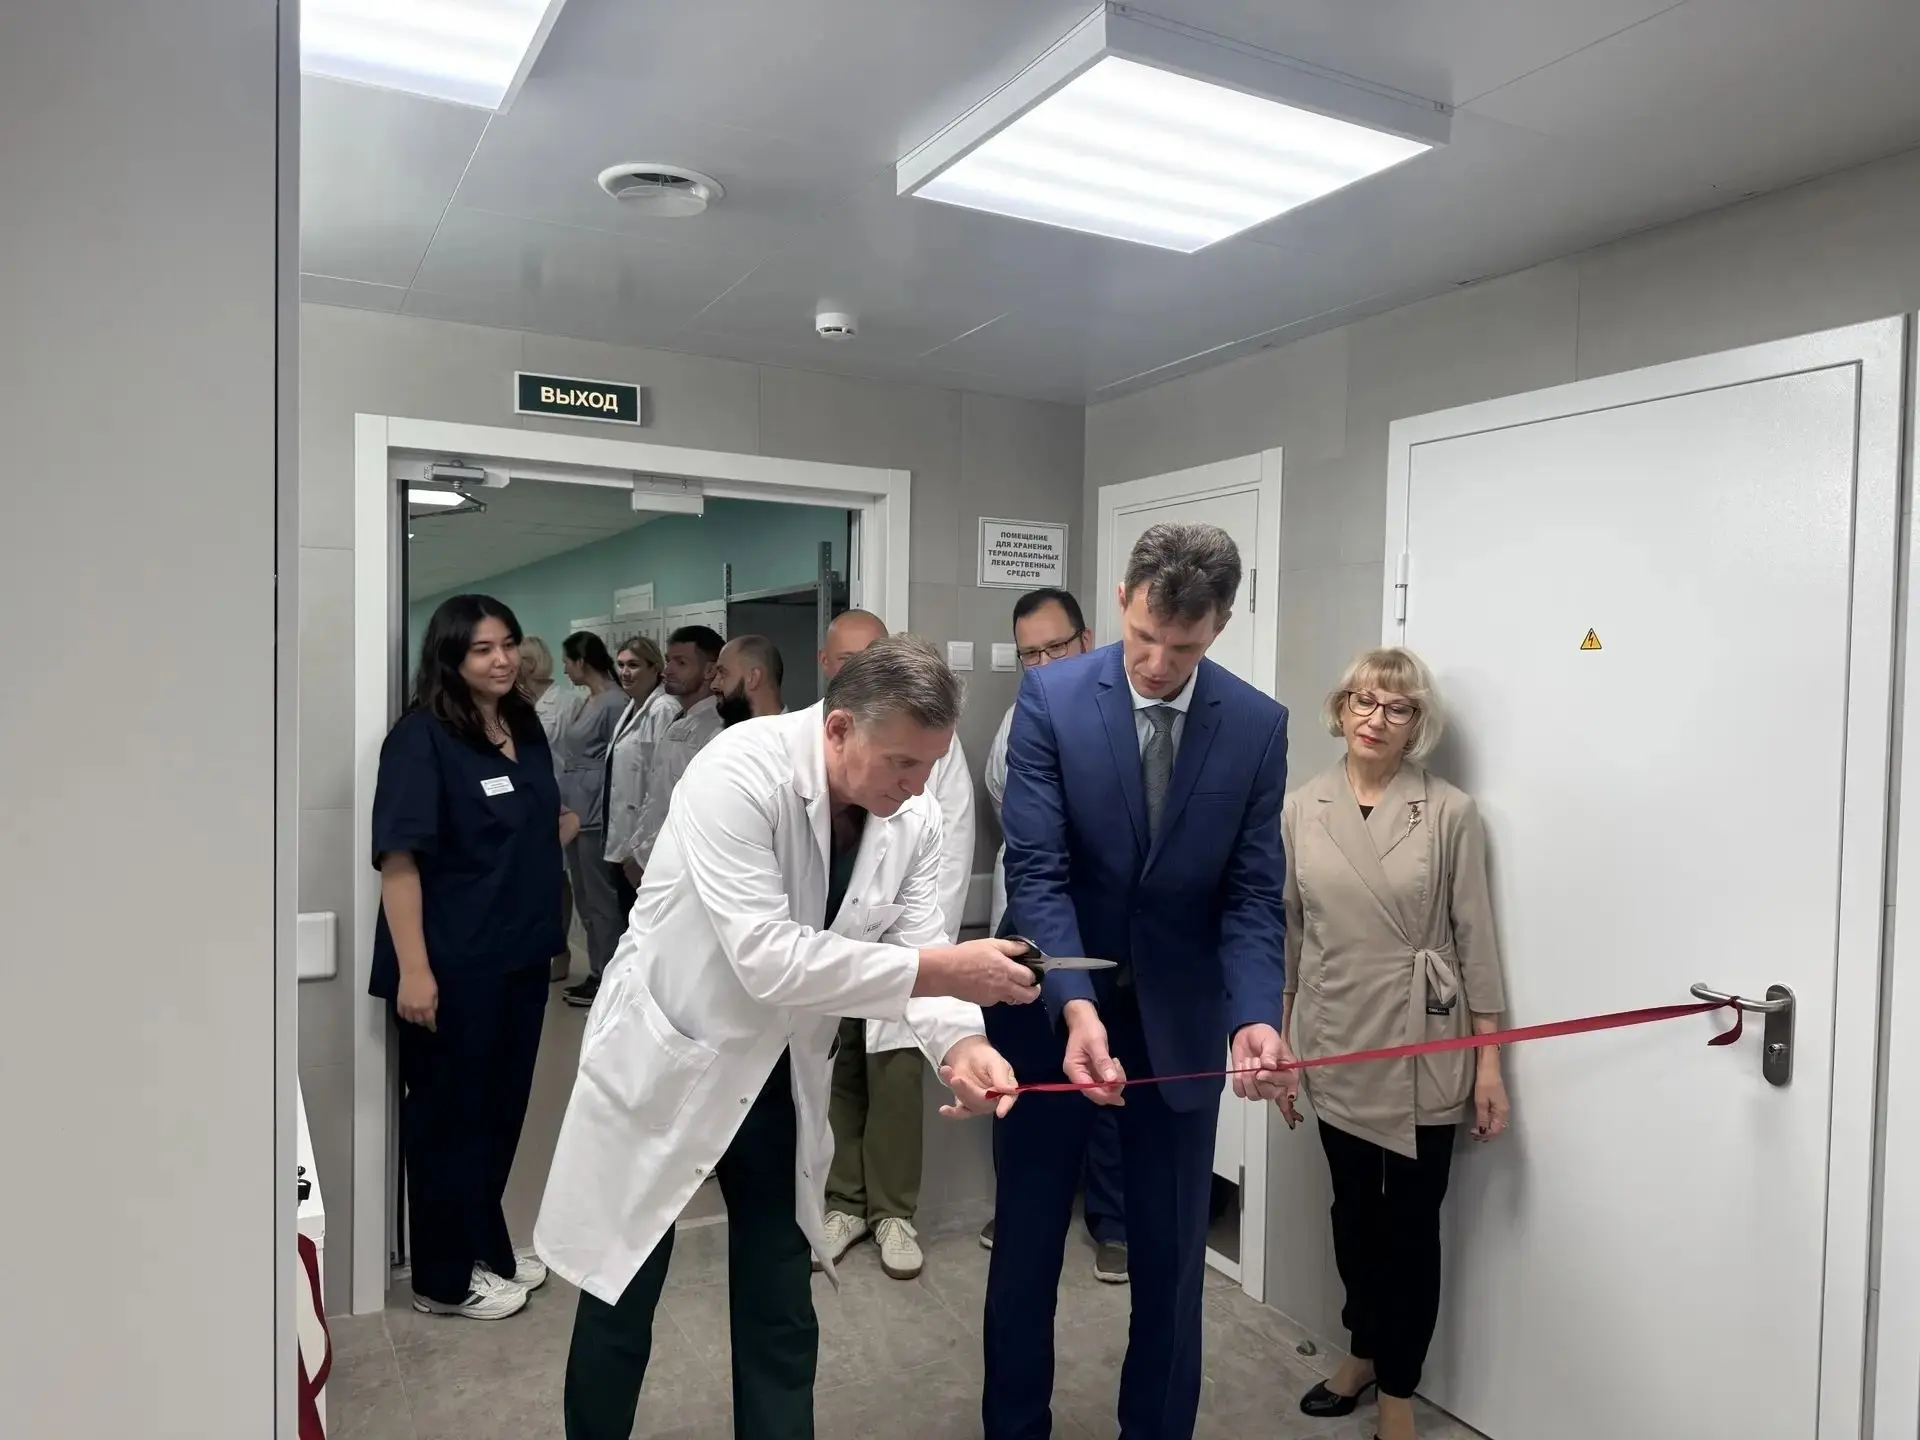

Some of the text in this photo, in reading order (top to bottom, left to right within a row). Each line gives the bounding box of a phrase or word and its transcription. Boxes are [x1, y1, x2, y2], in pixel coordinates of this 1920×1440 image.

[541, 386, 618, 413] ВЫХОД
[1001, 532, 1048, 541] ПОМЕЩЕНИЕ
[1013, 542, 1052, 551] ХРАНЕНИЯ
[988, 549, 1059, 560] ТЕРМОЛАБИЛЬНЫХ
[991, 559, 1056, 569] ЛЕКАРСТВЕННЫХ
